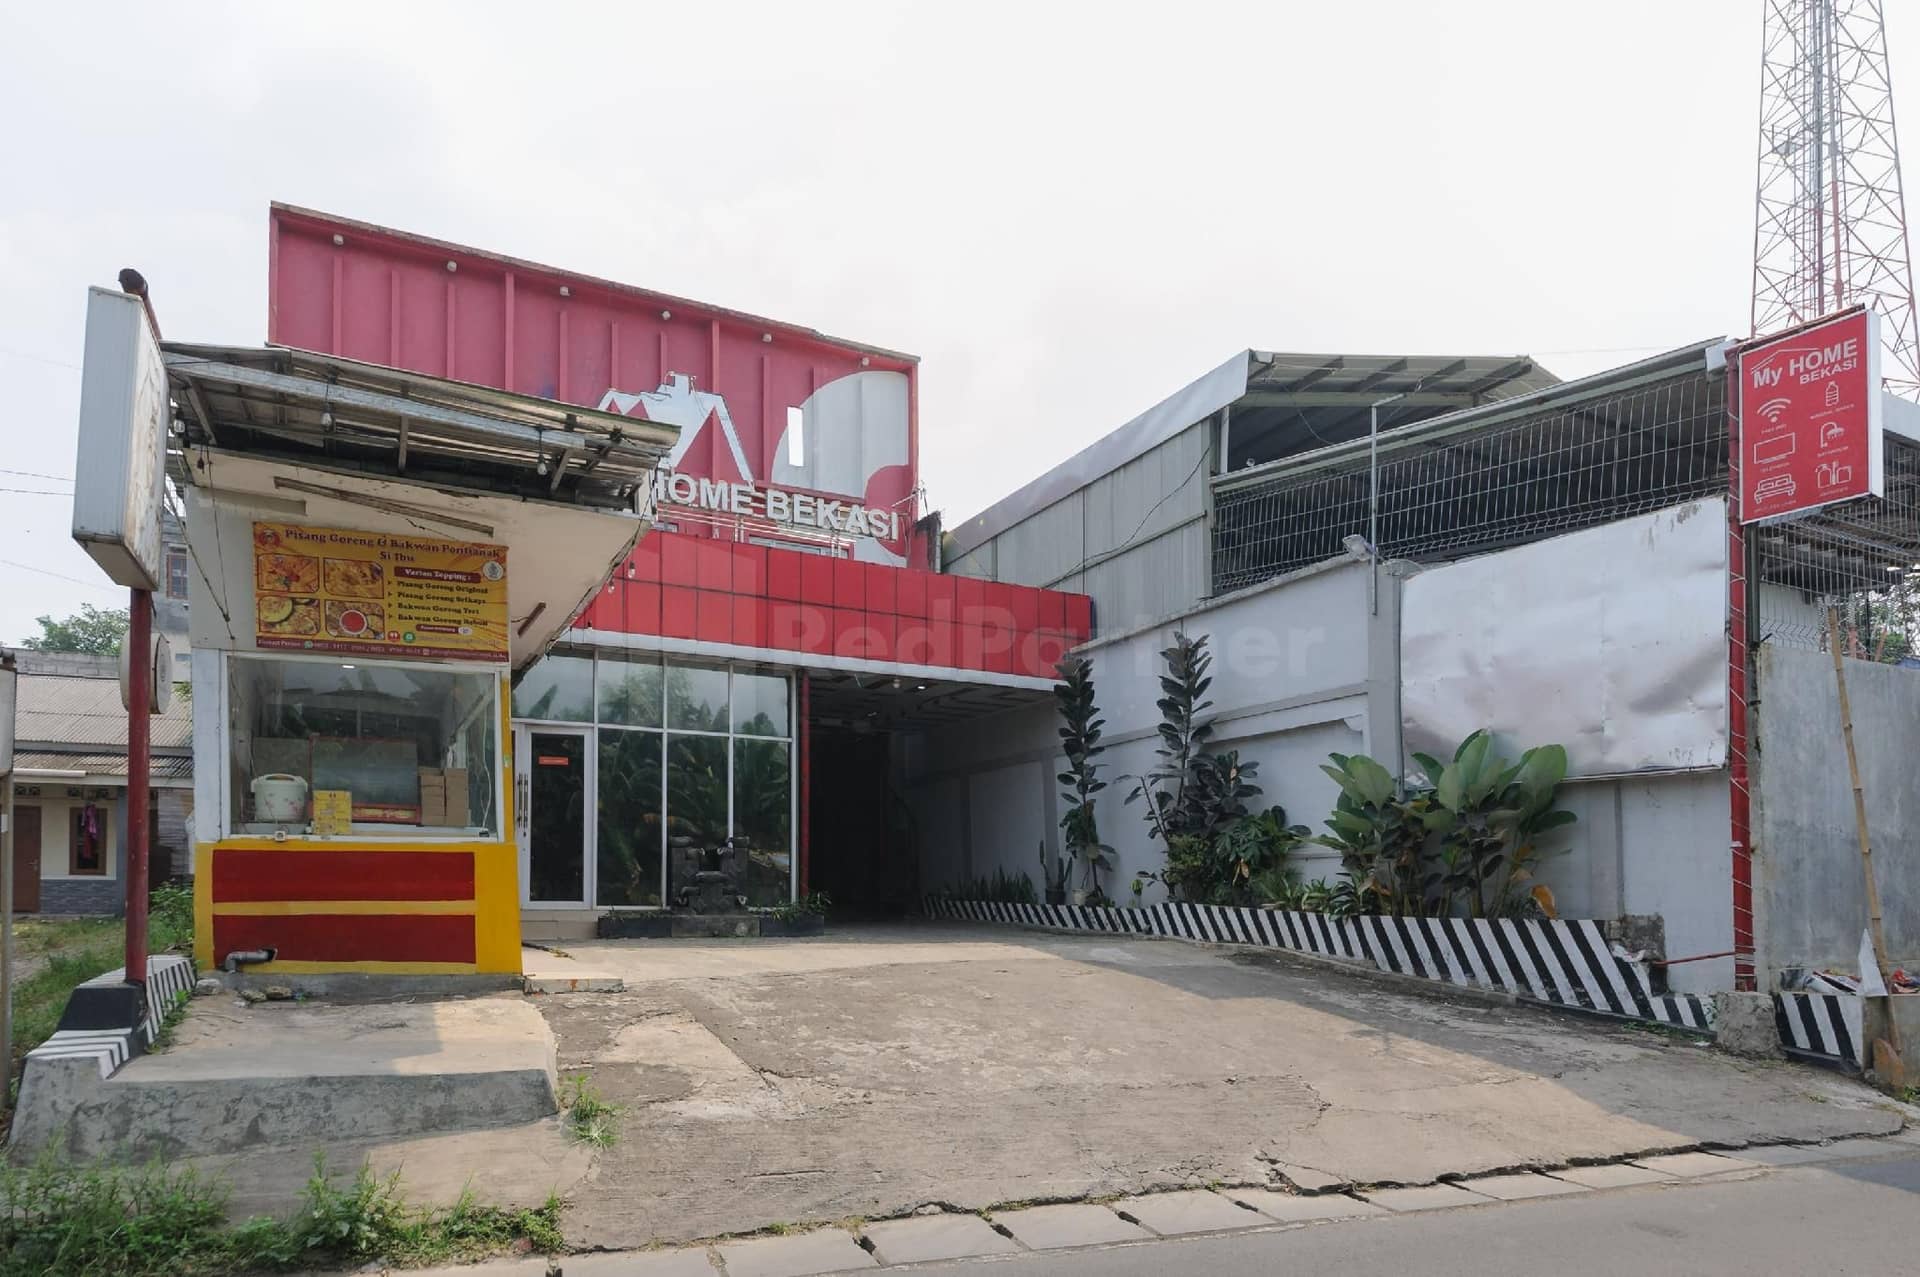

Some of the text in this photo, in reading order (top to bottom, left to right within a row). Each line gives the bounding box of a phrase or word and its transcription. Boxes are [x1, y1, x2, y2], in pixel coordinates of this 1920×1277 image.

[1753, 338, 1858, 389] My HOME
[1799, 357, 1857, 385] BEKASI
[766, 489, 899, 540] BEKASI
[285, 529, 326, 543] Pisang
[329, 533, 374, 547] Goreng
[390, 539, 439, 552] Bakwan
[441, 543, 501, 558] Pontianak
[379, 550, 392, 560] Si
